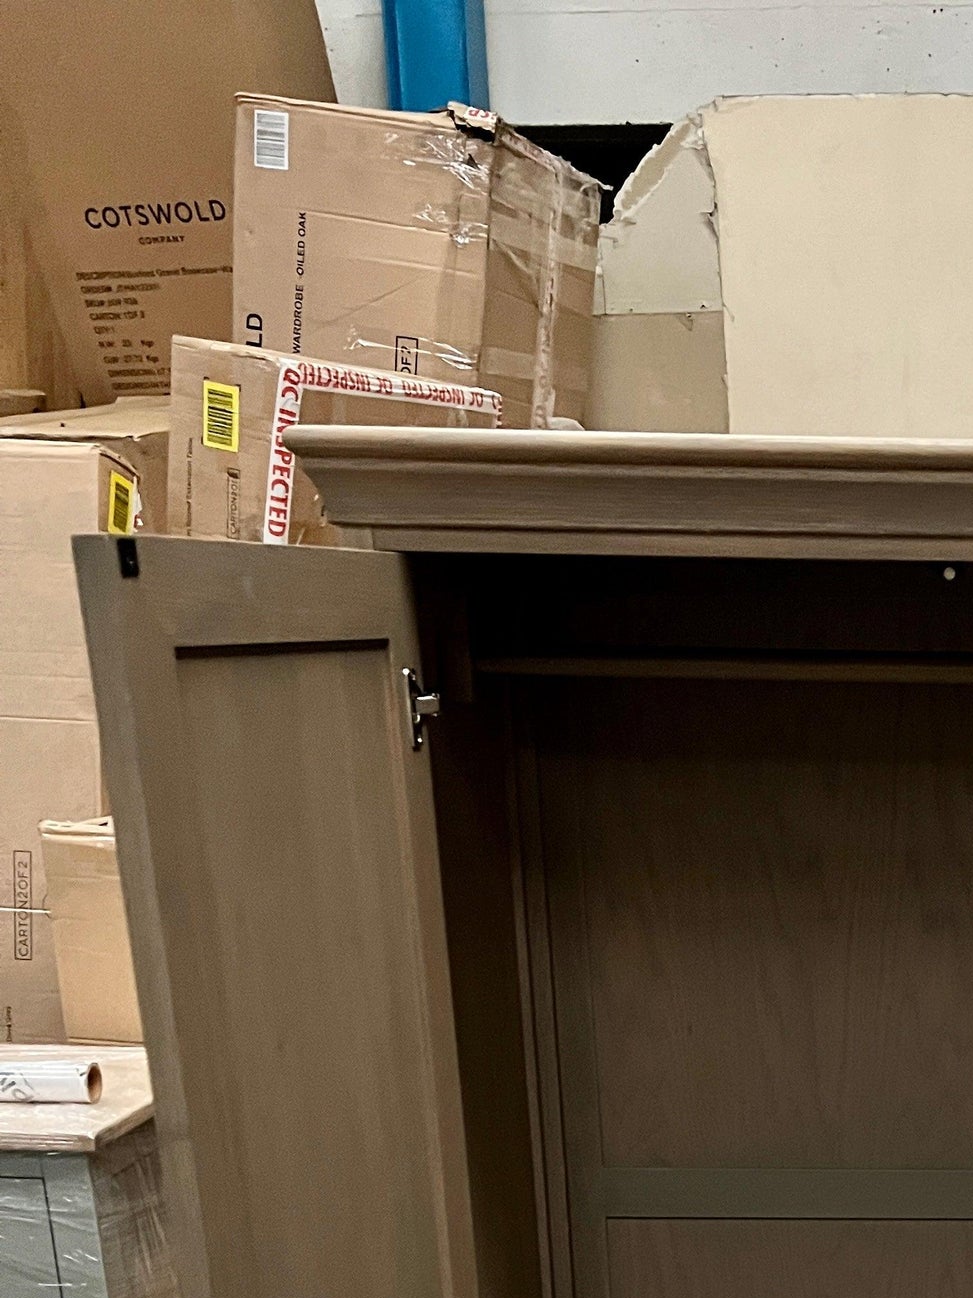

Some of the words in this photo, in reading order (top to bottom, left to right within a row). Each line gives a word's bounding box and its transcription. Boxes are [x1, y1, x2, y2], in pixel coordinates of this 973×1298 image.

[85, 199, 226, 230] COTSWOLD
[138, 235, 186, 246] COMPANY
[292, 284, 304, 354] WARDROBE
[298, 212, 306, 237] OAK
[282, 368, 300, 402] QC
